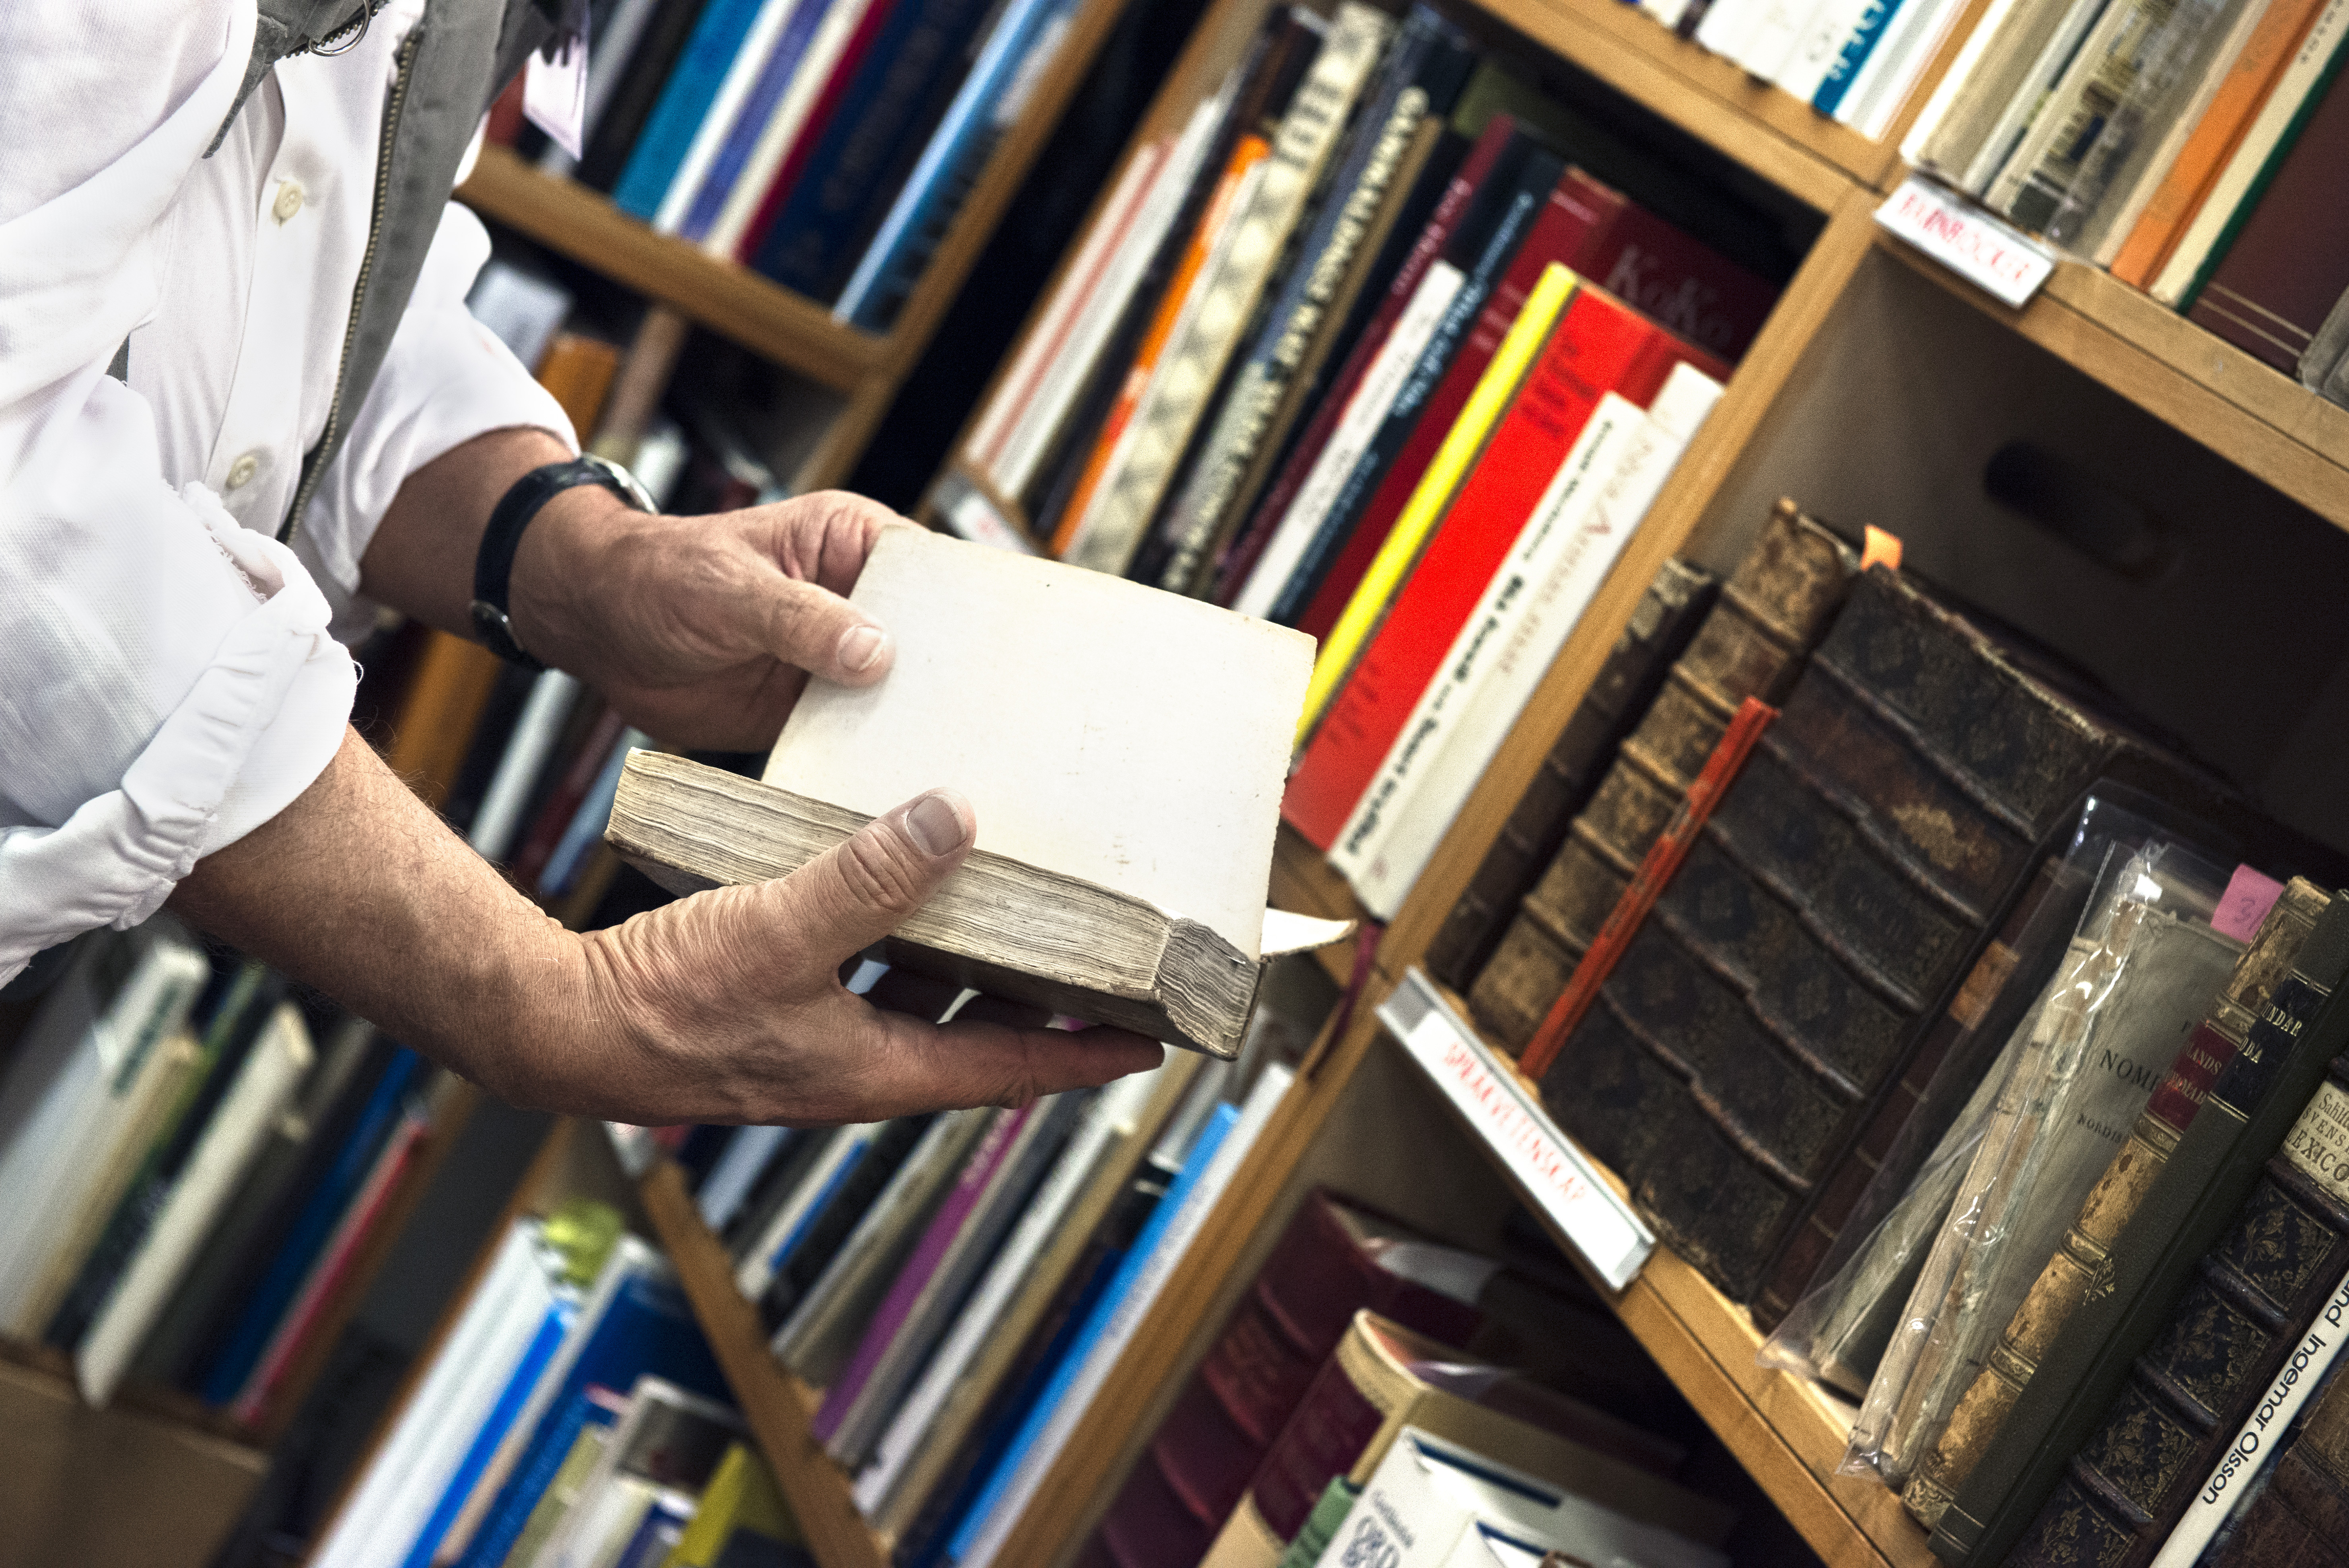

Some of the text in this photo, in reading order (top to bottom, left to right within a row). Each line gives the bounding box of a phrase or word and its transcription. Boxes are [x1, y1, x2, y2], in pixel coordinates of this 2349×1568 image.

[2098, 1049, 2160, 1094] NOMI
[2076, 1113, 2123, 1145] NORDIS
[2287, 1125, 2349, 1182] LEXICO
[2302, 1107, 2349, 1156] SVENS
[2254, 1333, 2327, 1432] Ingemar
[2202, 1430, 2259, 1506] Olsson
